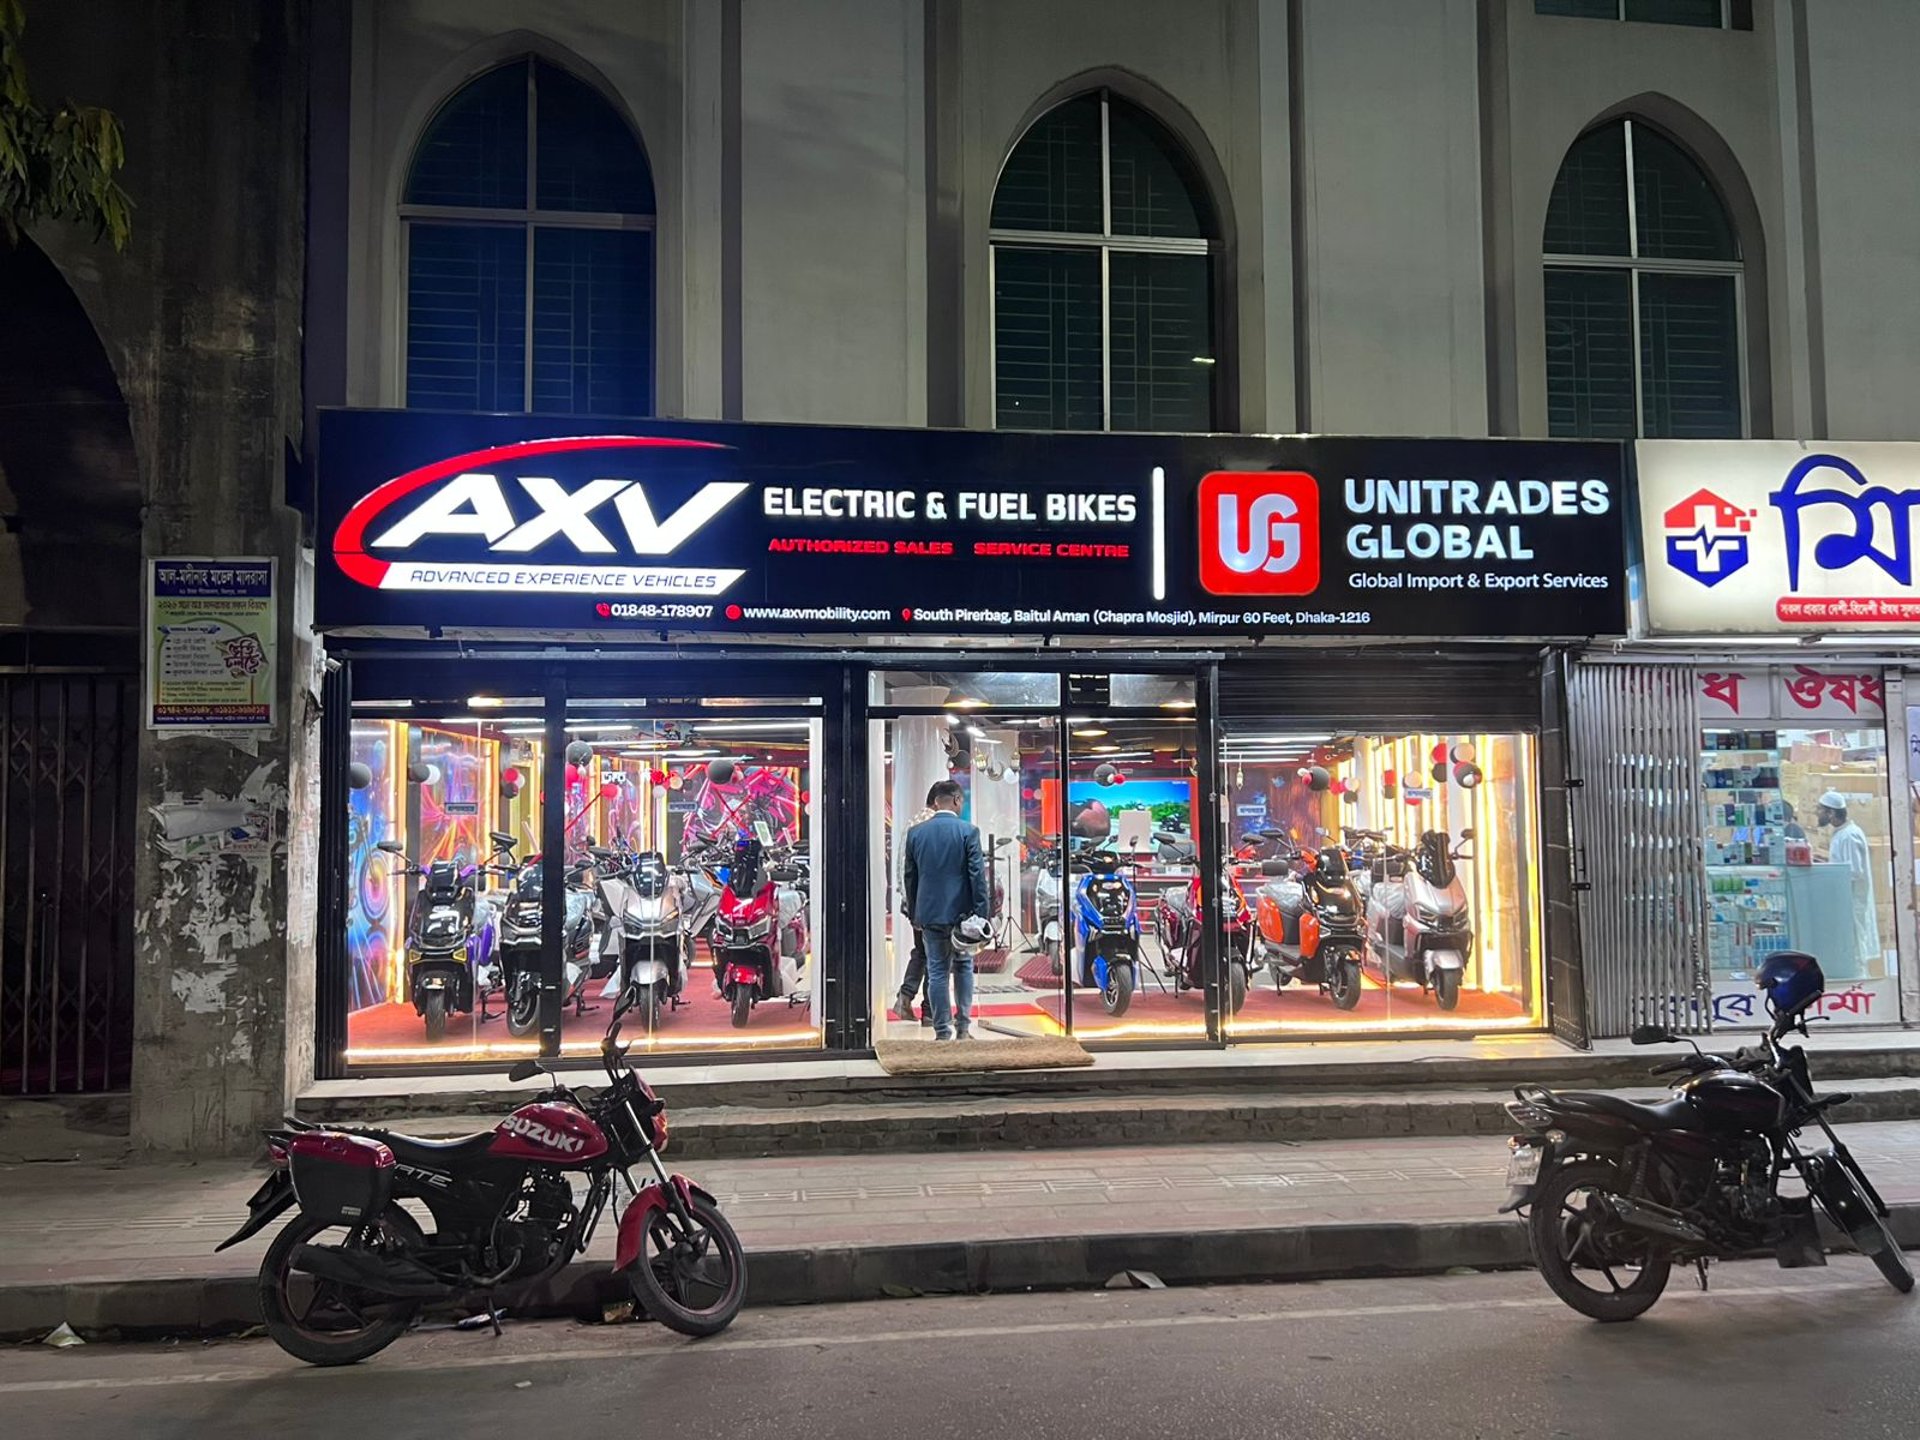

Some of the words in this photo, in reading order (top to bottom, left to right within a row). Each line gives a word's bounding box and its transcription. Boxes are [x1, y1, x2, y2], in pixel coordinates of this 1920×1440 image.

[763, 486, 915, 518] ELECTRIC
[926, 491, 947, 520] &
[958, 491, 1036, 521] FUEL
[1046, 493, 1137, 523] BIKES
[1344, 477, 1610, 515] UNITRADES
[370, 473, 752, 555] AXV
[1217, 492, 1301, 574] UG
[1346, 524, 1534, 560] GLOBAL
[767, 537, 889, 555] AUTHORIZED
[894, 540, 955, 556] SALES
[973, 541, 1052, 557] SERVICE
[1056, 543, 1130, 558] CENTRE
[410, 569, 510, 585] ADVANCED
[514, 571, 625, 587] EXPERIENCE
[632, 574, 718, 588] VEHICLES
[1348, 572, 1403, 588] Global
[1407, 572, 1464, 592] Import
[1467, 573, 1481, 588] &
[1485, 573, 1539, 593] Export
[1542, 573, 1609, 589] Services
[610, 603, 714, 619] 01848-178907
[743, 607, 891, 623] www.axvmobility.com
[913, 608, 953, 622] South
[955, 609, 1012, 625] Pirerbag,
[1014, 609, 1051, 623] Baitul
[1053, 611, 1090, 623] Aman
[1093, 610, 1145, 626] (Chapra
[1146, 610, 1197, 626] Mosjid),
[1198, 611, 1240, 626] Mirpur
[1243, 612, 1261, 624] 60
[1263, 611, 1294, 626] Feet,
[1296, 612, 1371, 624] Dhaka-1216
[501, 1115, 585, 1153] SUZUKI
